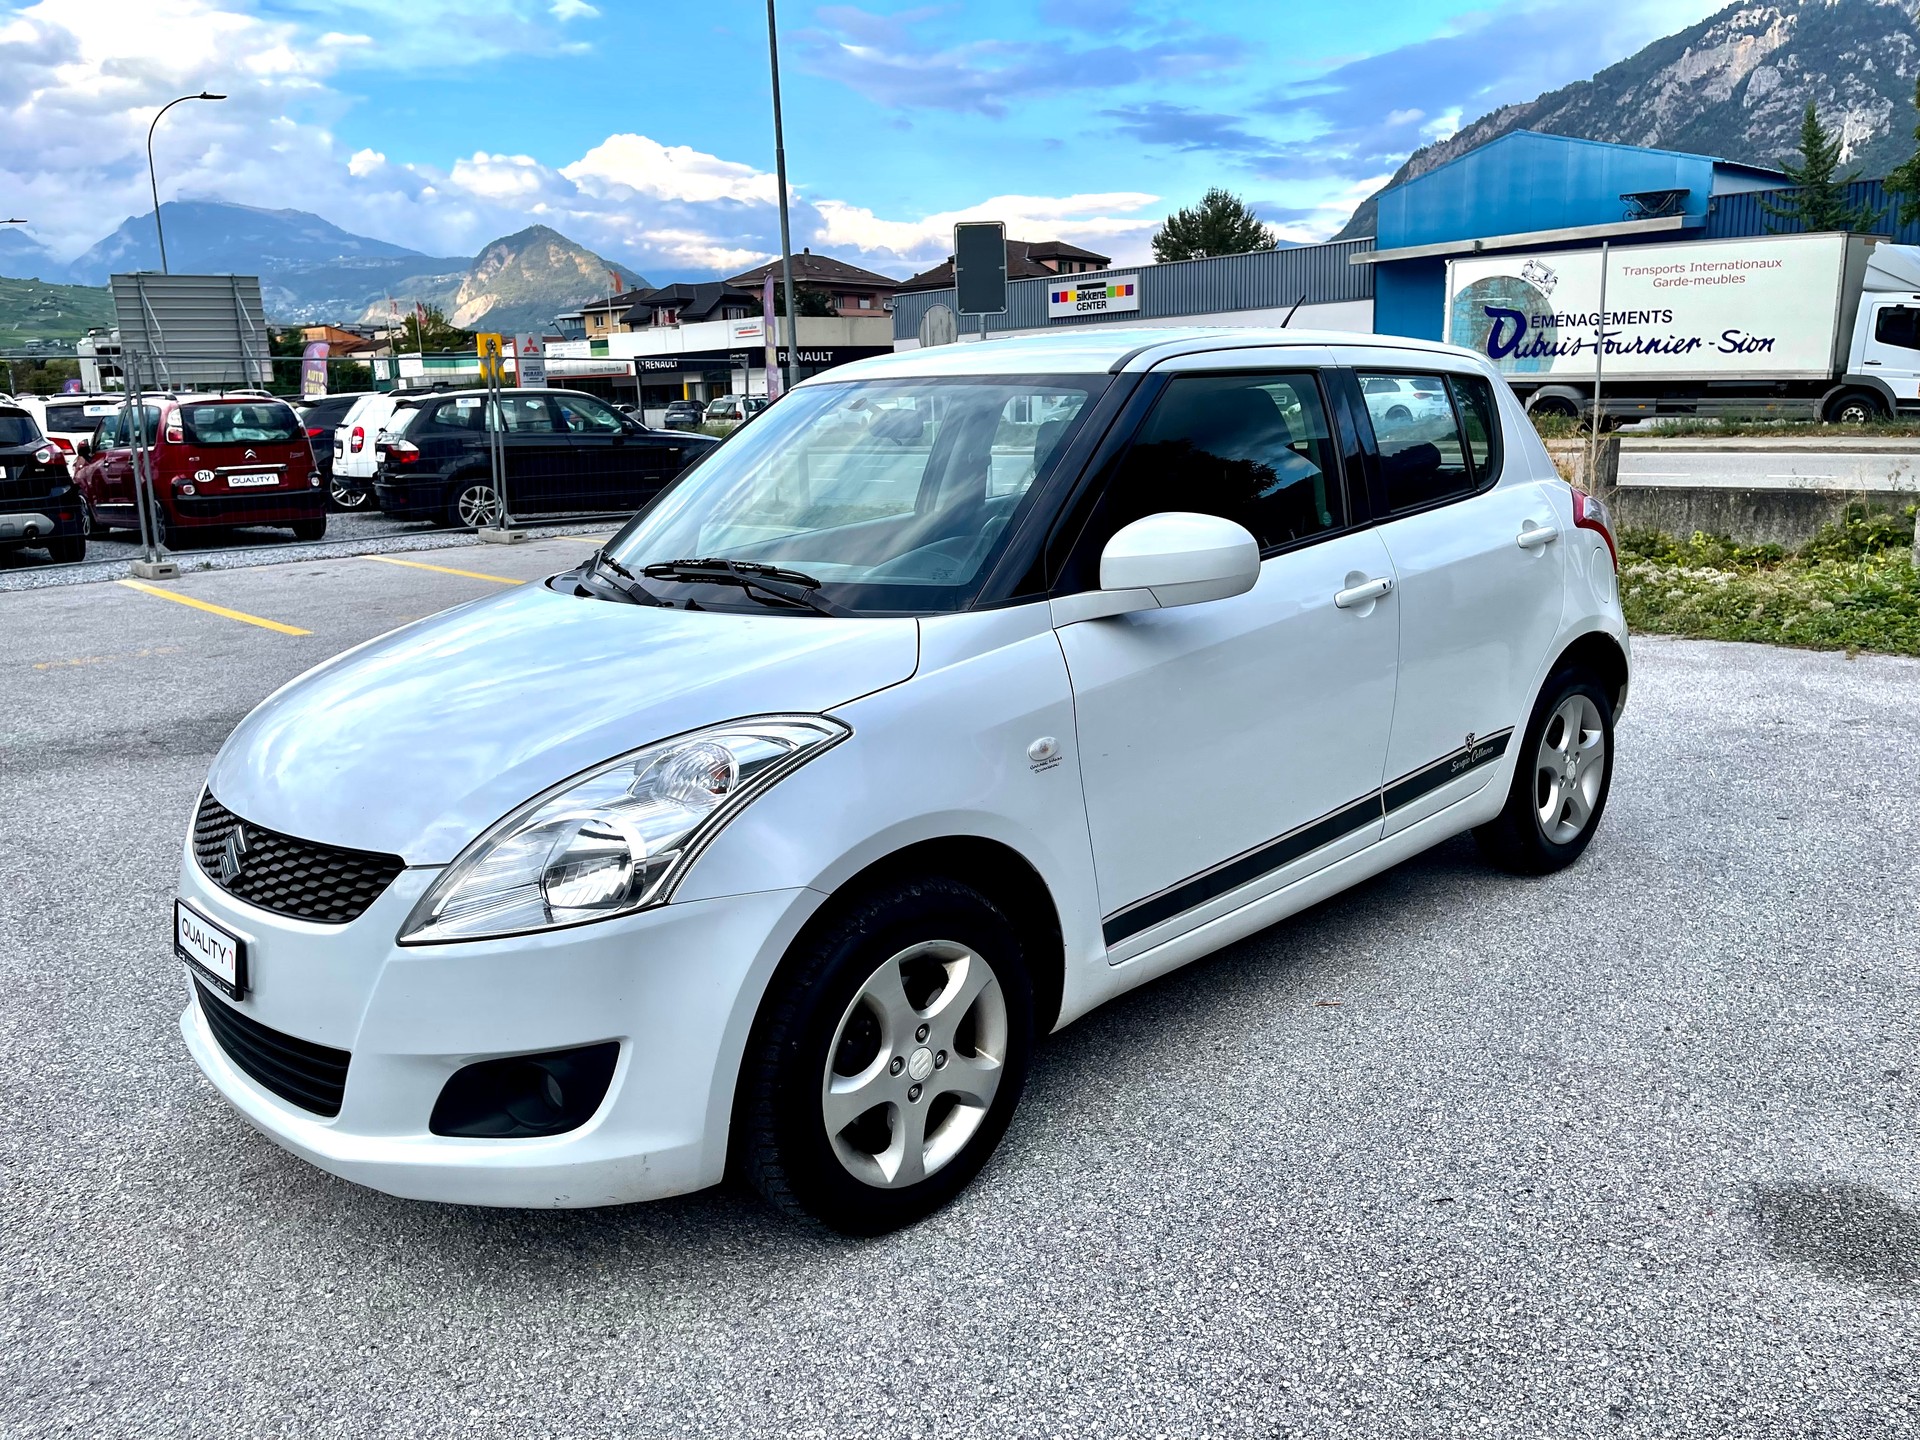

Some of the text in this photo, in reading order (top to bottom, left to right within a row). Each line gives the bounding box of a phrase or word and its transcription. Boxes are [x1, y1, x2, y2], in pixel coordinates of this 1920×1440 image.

[1623, 258, 1783, 276] Transports Internationaux
[1653, 273, 1746, 288] Garde-meubles
[1076, 290, 1107, 301] sikkens
[1076, 300, 1107, 311] CENTER
[1717, 329, 1776, 354] Sion
[645, 358, 678, 370] RENAULT
[306, 369, 325, 383] AUTO
[197, 472, 211, 481] CH
